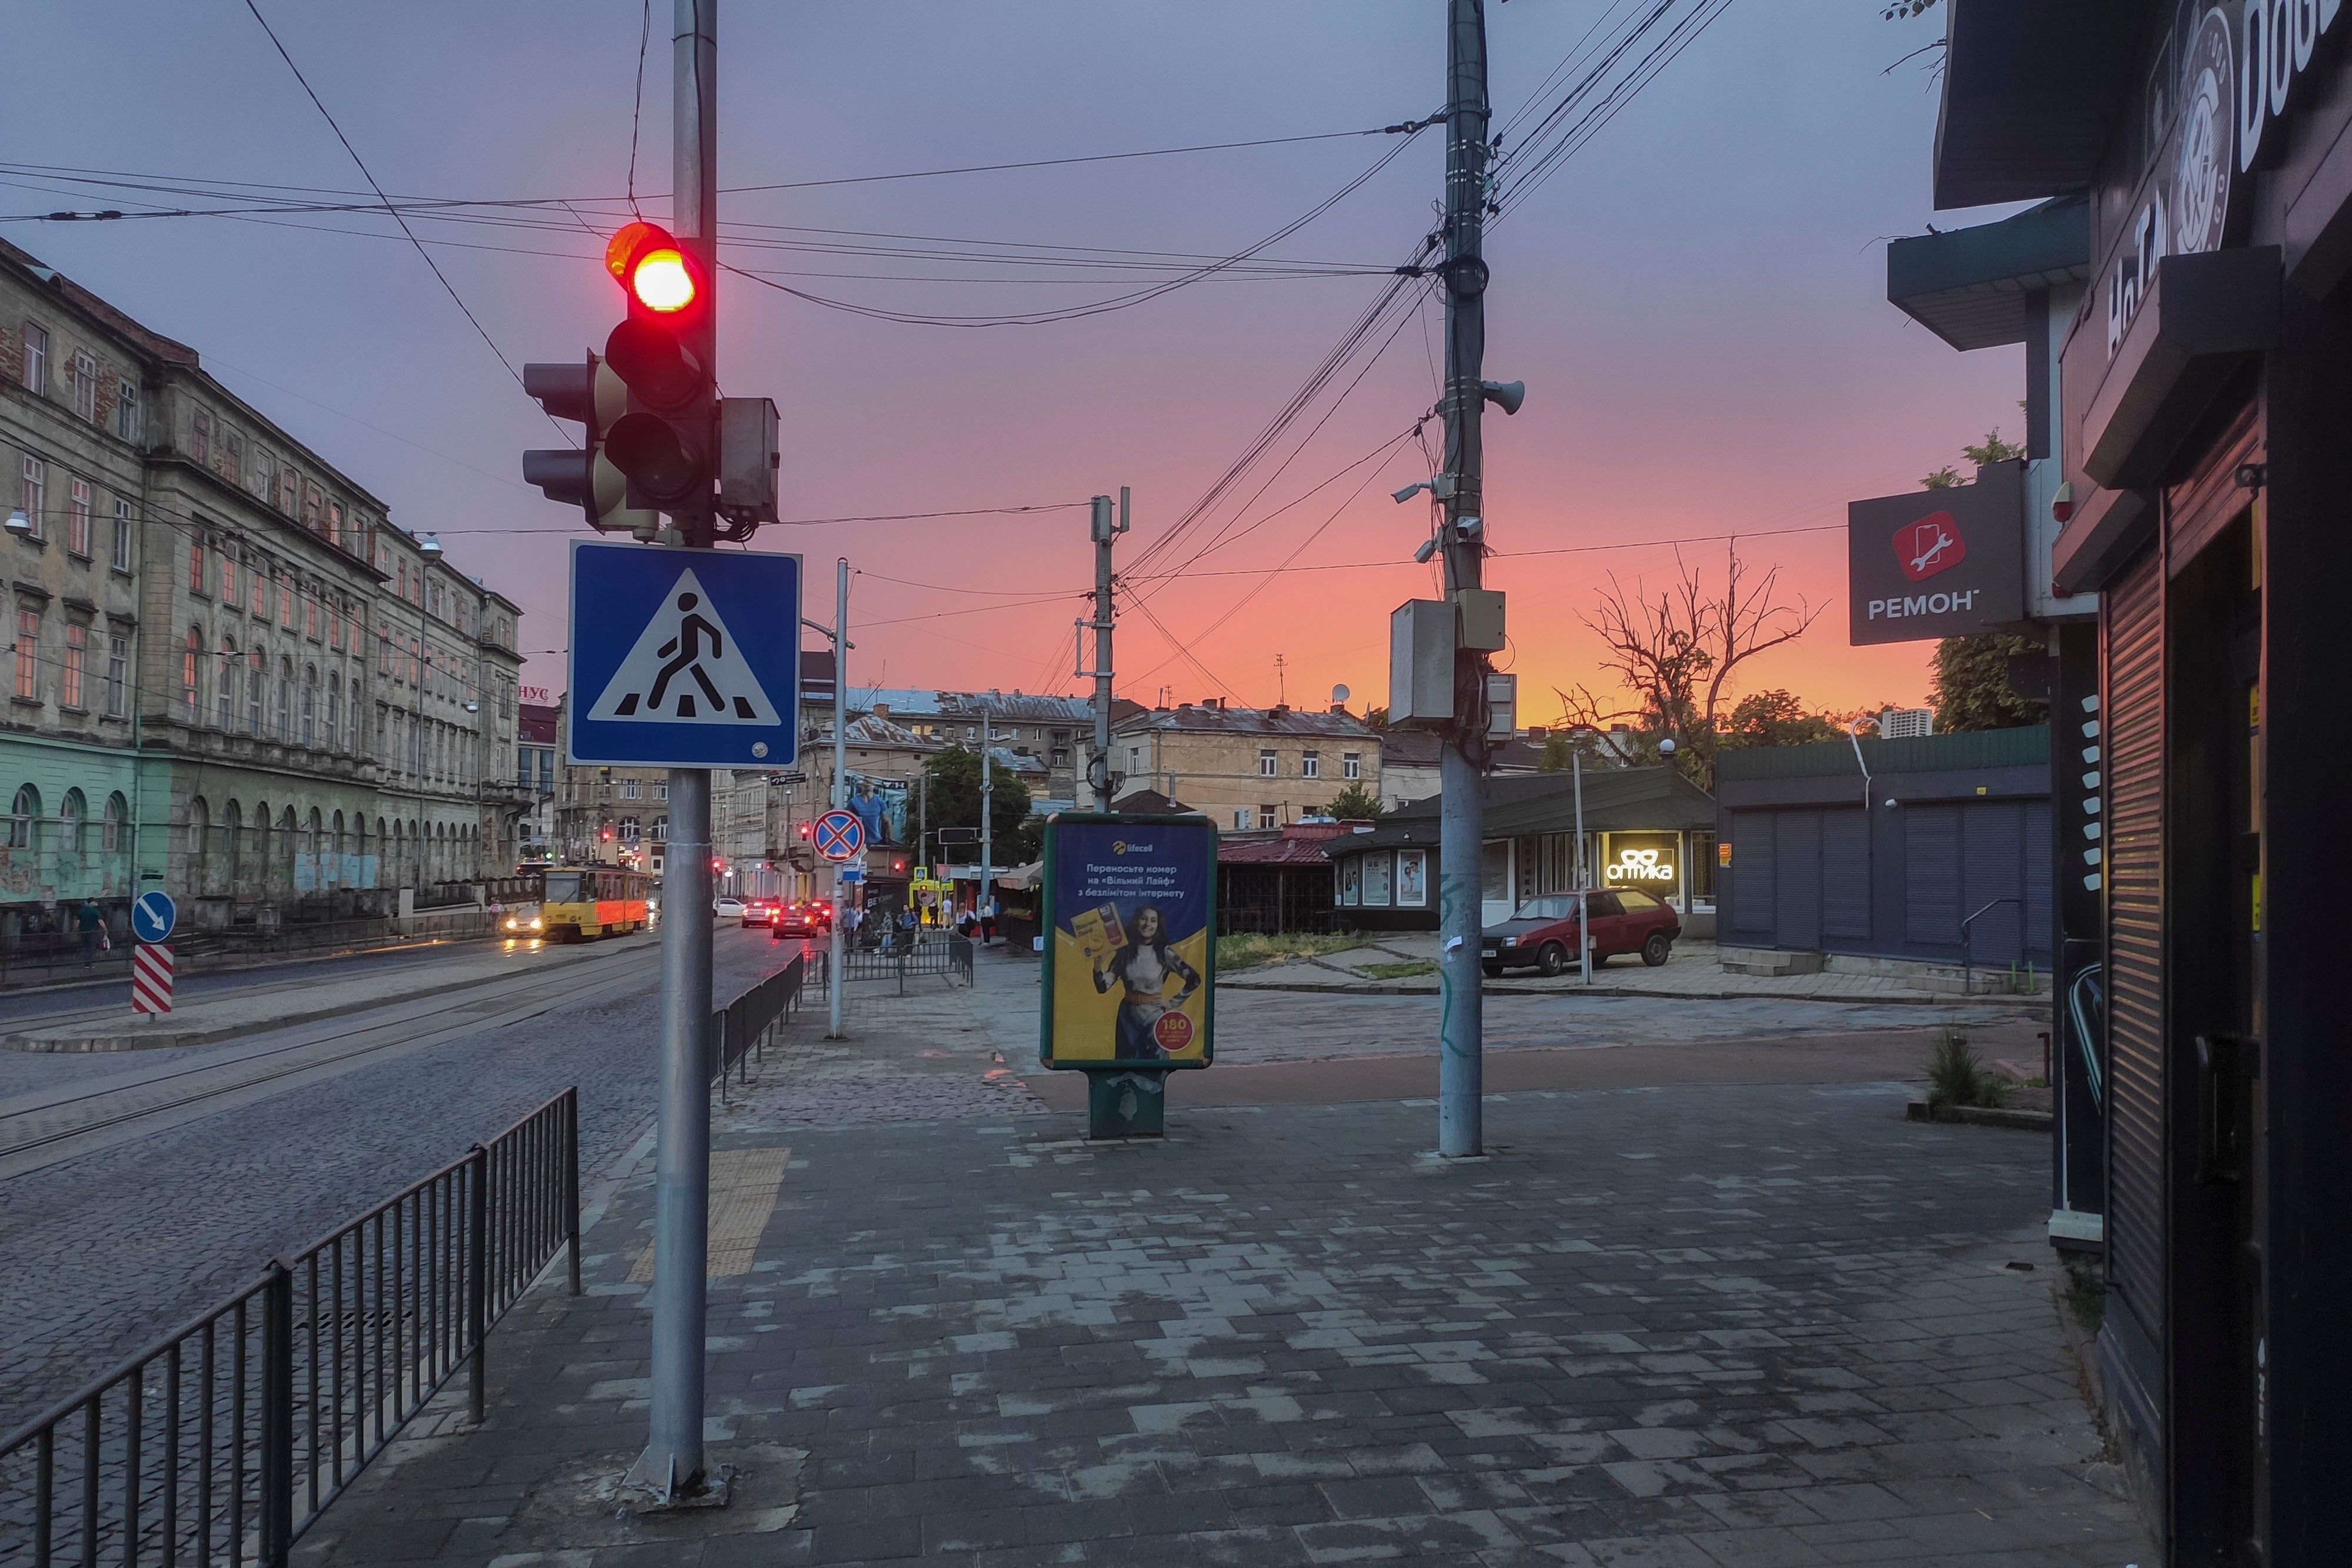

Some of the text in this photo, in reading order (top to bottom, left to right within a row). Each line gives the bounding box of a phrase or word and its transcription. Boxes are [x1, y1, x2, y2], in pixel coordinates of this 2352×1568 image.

[1868, 589, 1981, 620] РЕМОН
[1127, 844, 1153, 852] lifecell
[1087, 864, 1177, 875] Переносьте номер
[1145, 876, 1175, 886] Лайф»
[1085, 888, 1137, 896] безлімітом
[1139, 888, 1184, 899] інтернету
[1162, 1018, 1187, 1030] 180
